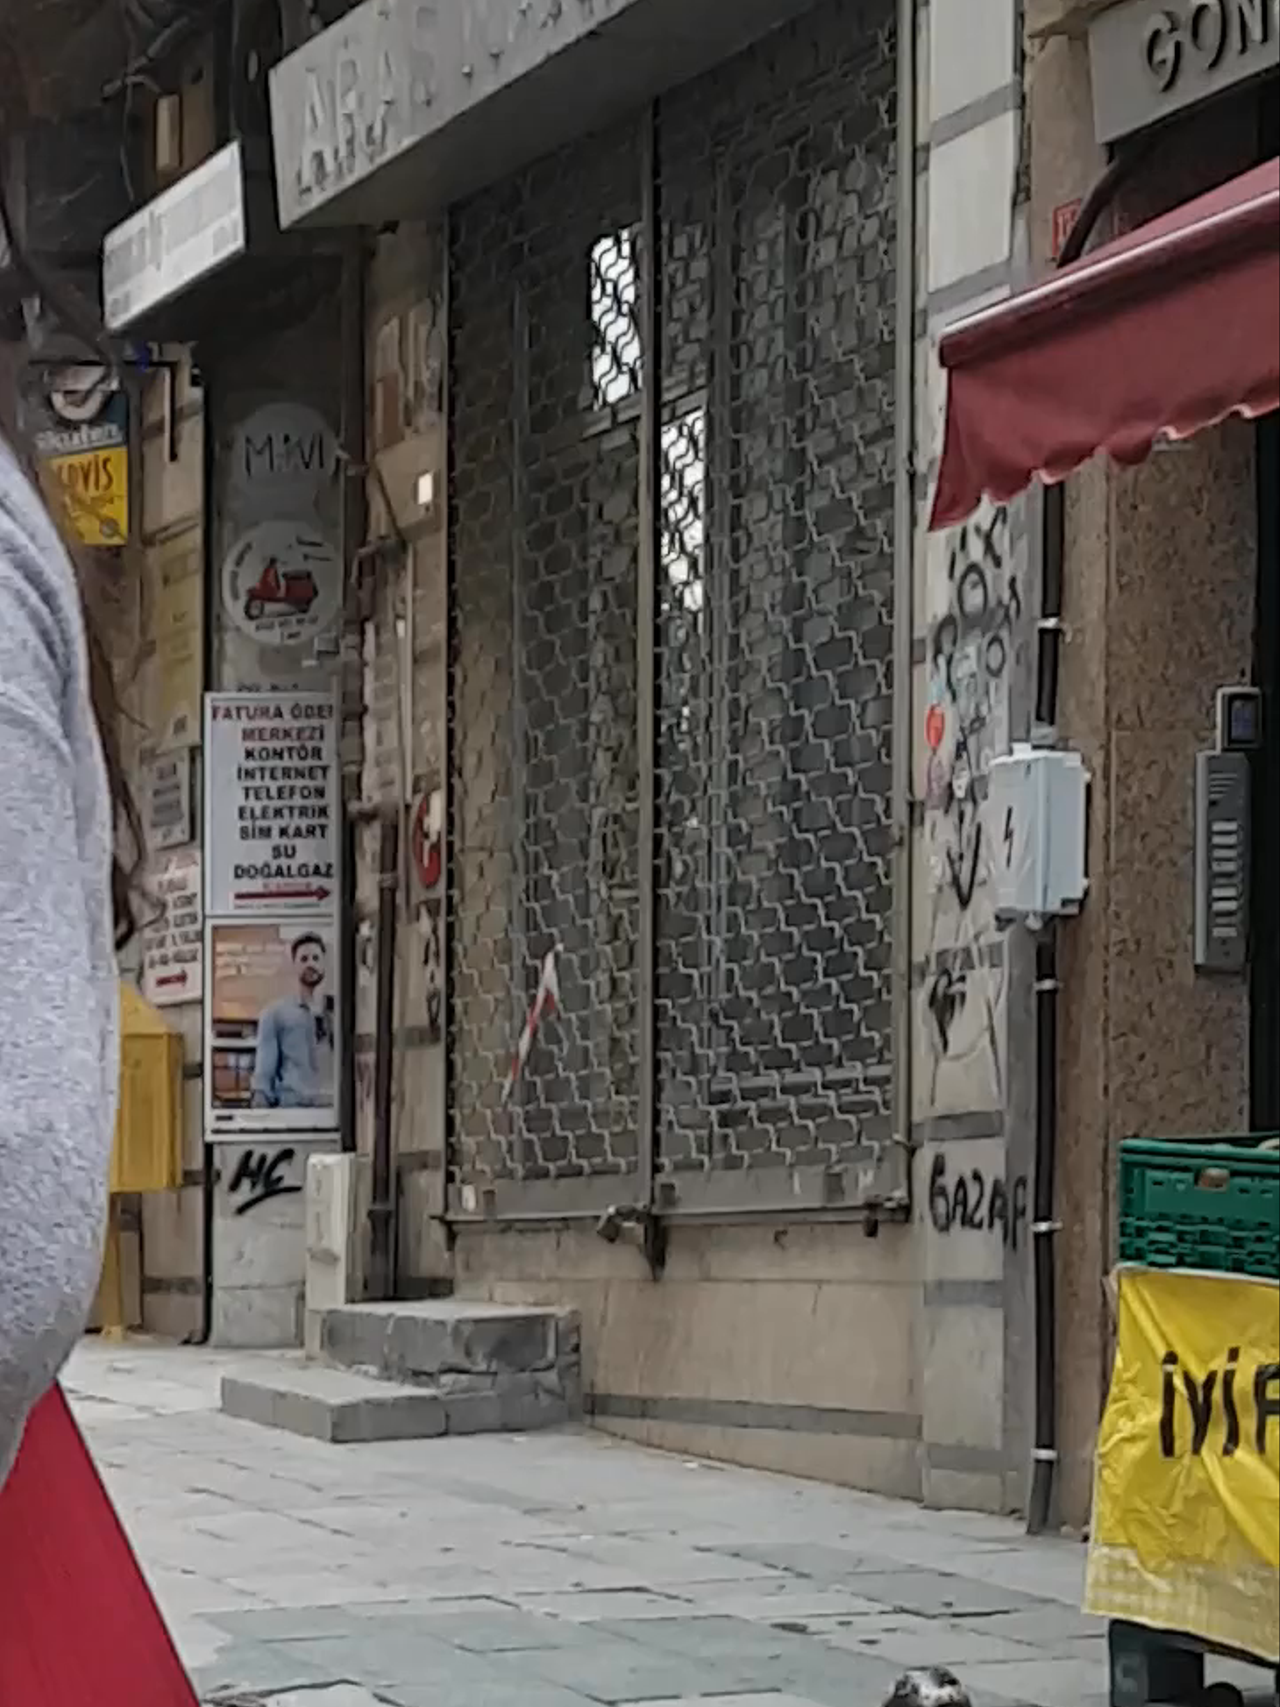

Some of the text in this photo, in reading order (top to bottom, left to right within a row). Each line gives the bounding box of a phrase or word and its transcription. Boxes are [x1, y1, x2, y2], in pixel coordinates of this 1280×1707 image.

[212, 704, 284, 721] FATURA
[241, 725, 325, 742] MERKEZİ
[244, 745, 323, 761] KONTÖR
[243, 786, 326, 801] TELEFON
[279, 824, 330, 840] KART
[272, 845, 297, 859] SU
[234, 862, 334, 879] DOĞALGAZ
